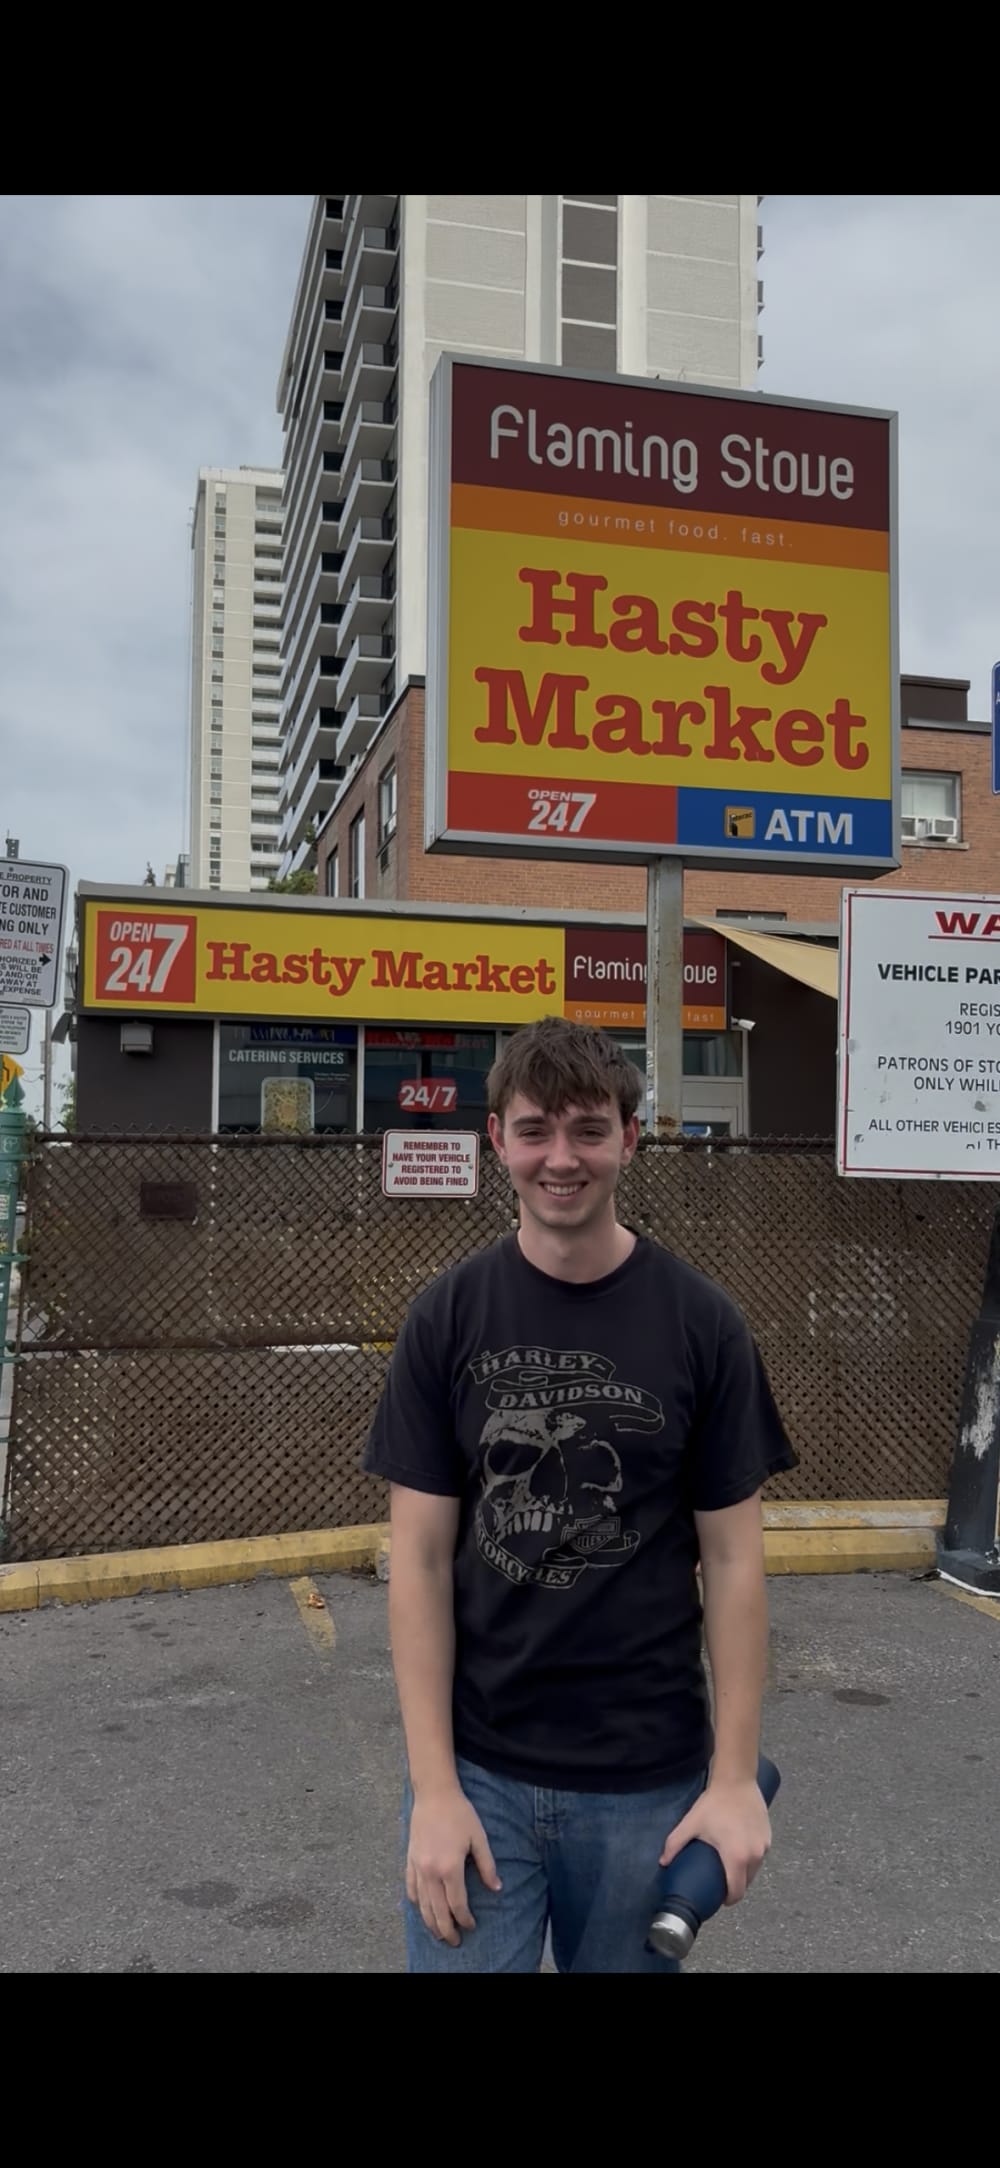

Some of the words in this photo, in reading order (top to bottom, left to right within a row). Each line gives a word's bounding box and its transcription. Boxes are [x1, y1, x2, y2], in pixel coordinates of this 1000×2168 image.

[489, 404, 698, 494] Flaming
[720, 433, 854, 500] Stove
[557, 510, 656, 534] gourmet
[517, 567, 828, 685] Hasty
[474, 666, 869, 770] Market
[527, 789, 570, 802] OPEN
[764, 808, 853, 845] ATM
[7, 872, 52, 884] PROPERTY
[23, 887, 48, 901] AND
[9, 902, 56, 919] CUSTOMER
[18, 920, 49, 935] ONLY
[109, 921, 153, 943] OPEN
[13, 939, 21, 950] AT
[35, 942, 54, 954] TIMES
[8, 964, 29, 972] WILL
[206, 942, 366, 997] Hasty
[371, 950, 556, 996] Market
[877, 963, 959, 983] VEHICLE
[3, 985, 41, 996] EXPENSE
[26, 980, 37, 988] AT
[945, 1020, 979, 1035] 1901
[228, 1049, 286, 1063] CATERING
[289, 1051, 344, 1065] SERVICES
[877, 1056, 948, 1072] PATRONS
[953, 1059, 973, 1073] OF
[914, 1076, 955, 1090] ONLY
[959, 1078, 1000, 1092] WHIL
[400, 1085, 456, 1109] 24/7
[868, 1119, 892, 1131] ALL
[895, 1119, 939, 1132] OTHER
[403, 1141, 448, 1151] REMEMBER
[450, 1142, 461, 1151] TO
[392, 1153, 413, 1162] HAVE
[415, 1154, 436, 1162] YOUR
[438, 1154, 470, 1163] VEHICLE
[401, 1165, 449, 1174] REGISTERED
[451, 1166, 462, 1175] TO
[393, 1176, 417, 1186] AVOID
[419, 1177, 444, 1186] BEING
[446, 1177, 469, 1187] FINED
[498, 1384, 643, 1409] DAVIDSON
